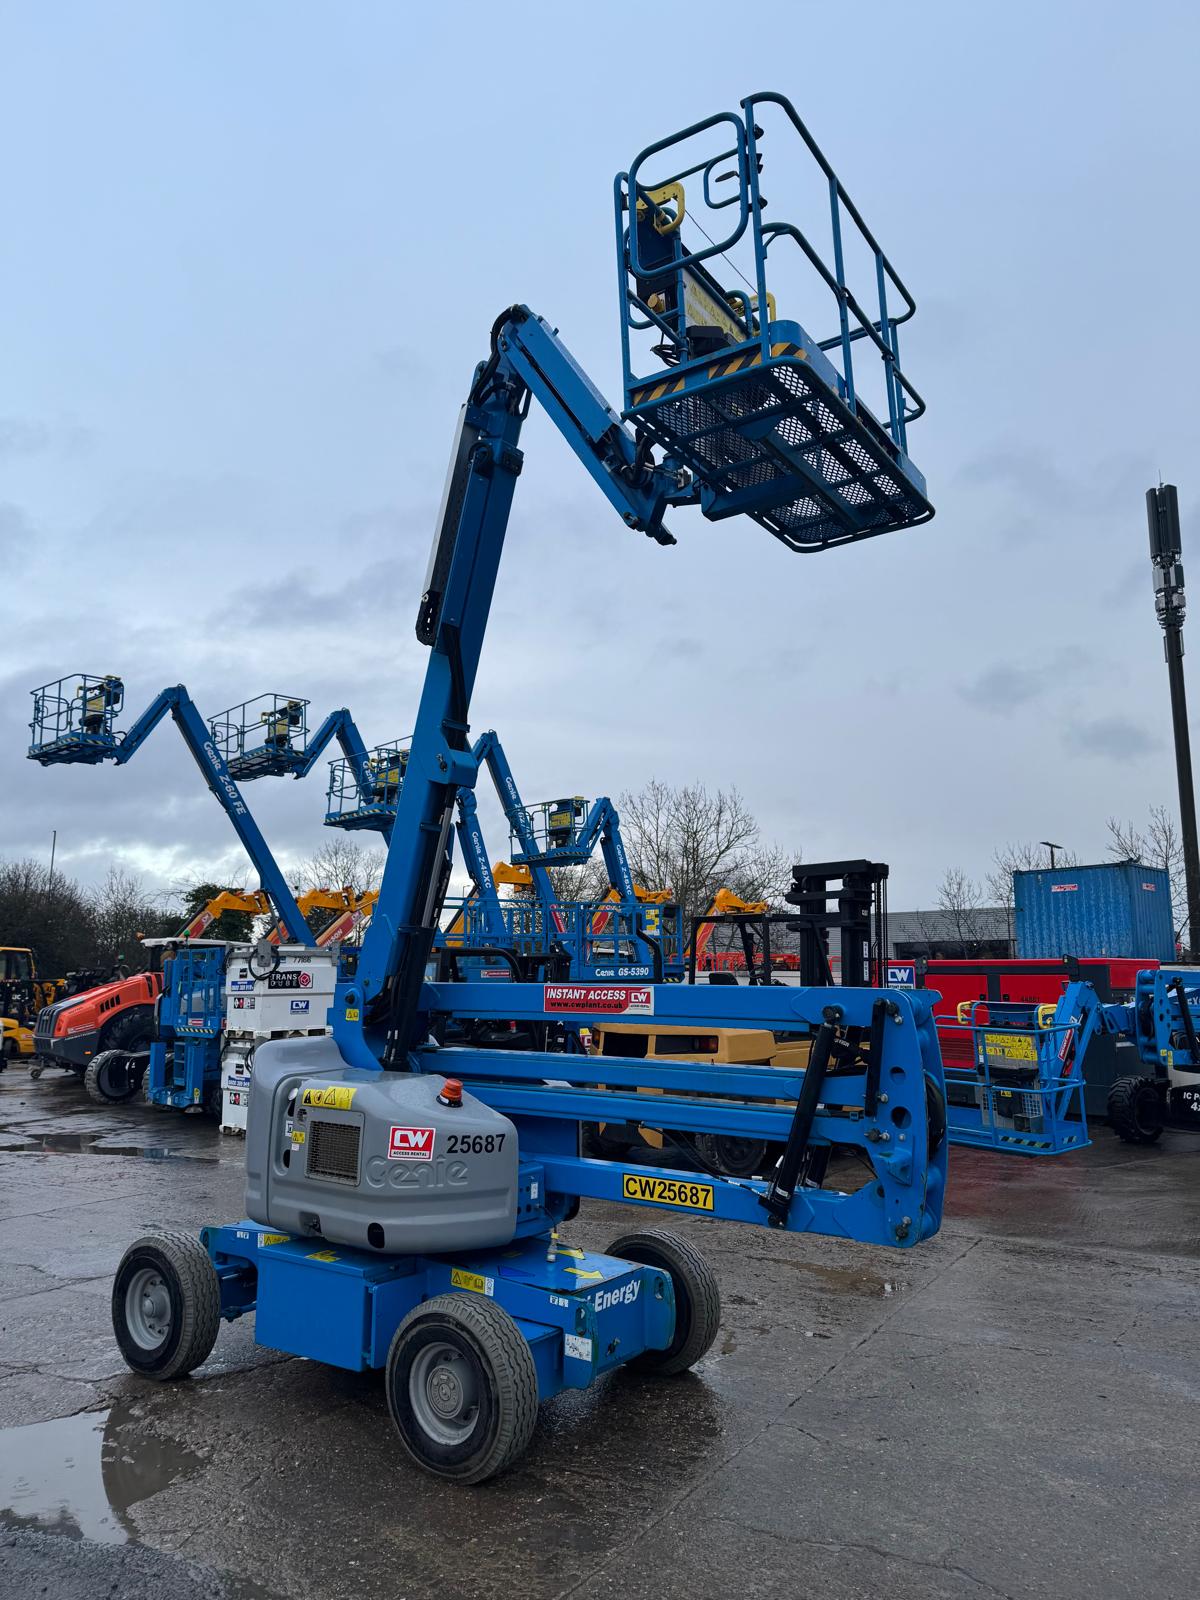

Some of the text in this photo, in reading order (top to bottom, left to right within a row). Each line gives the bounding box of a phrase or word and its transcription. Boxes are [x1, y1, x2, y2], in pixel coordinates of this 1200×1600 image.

[204, 741, 247, 815] Genie Z-60 FE
[472, 831, 481, 855] Genie
[595, 967, 649, 977] Genie GS-5390
[546, 988, 626, 1000] INSTANT ACCESS
[631, 993, 648, 1002] CW
[551, 1001, 623, 1009] www.cwplant.co.uk
[393, 1130, 430, 1148] CW
[446, 1133, 506, 1154] 25687
[625, 1177, 711, 1207] CW25687
[589, 1279, 641, 1313] Energy
